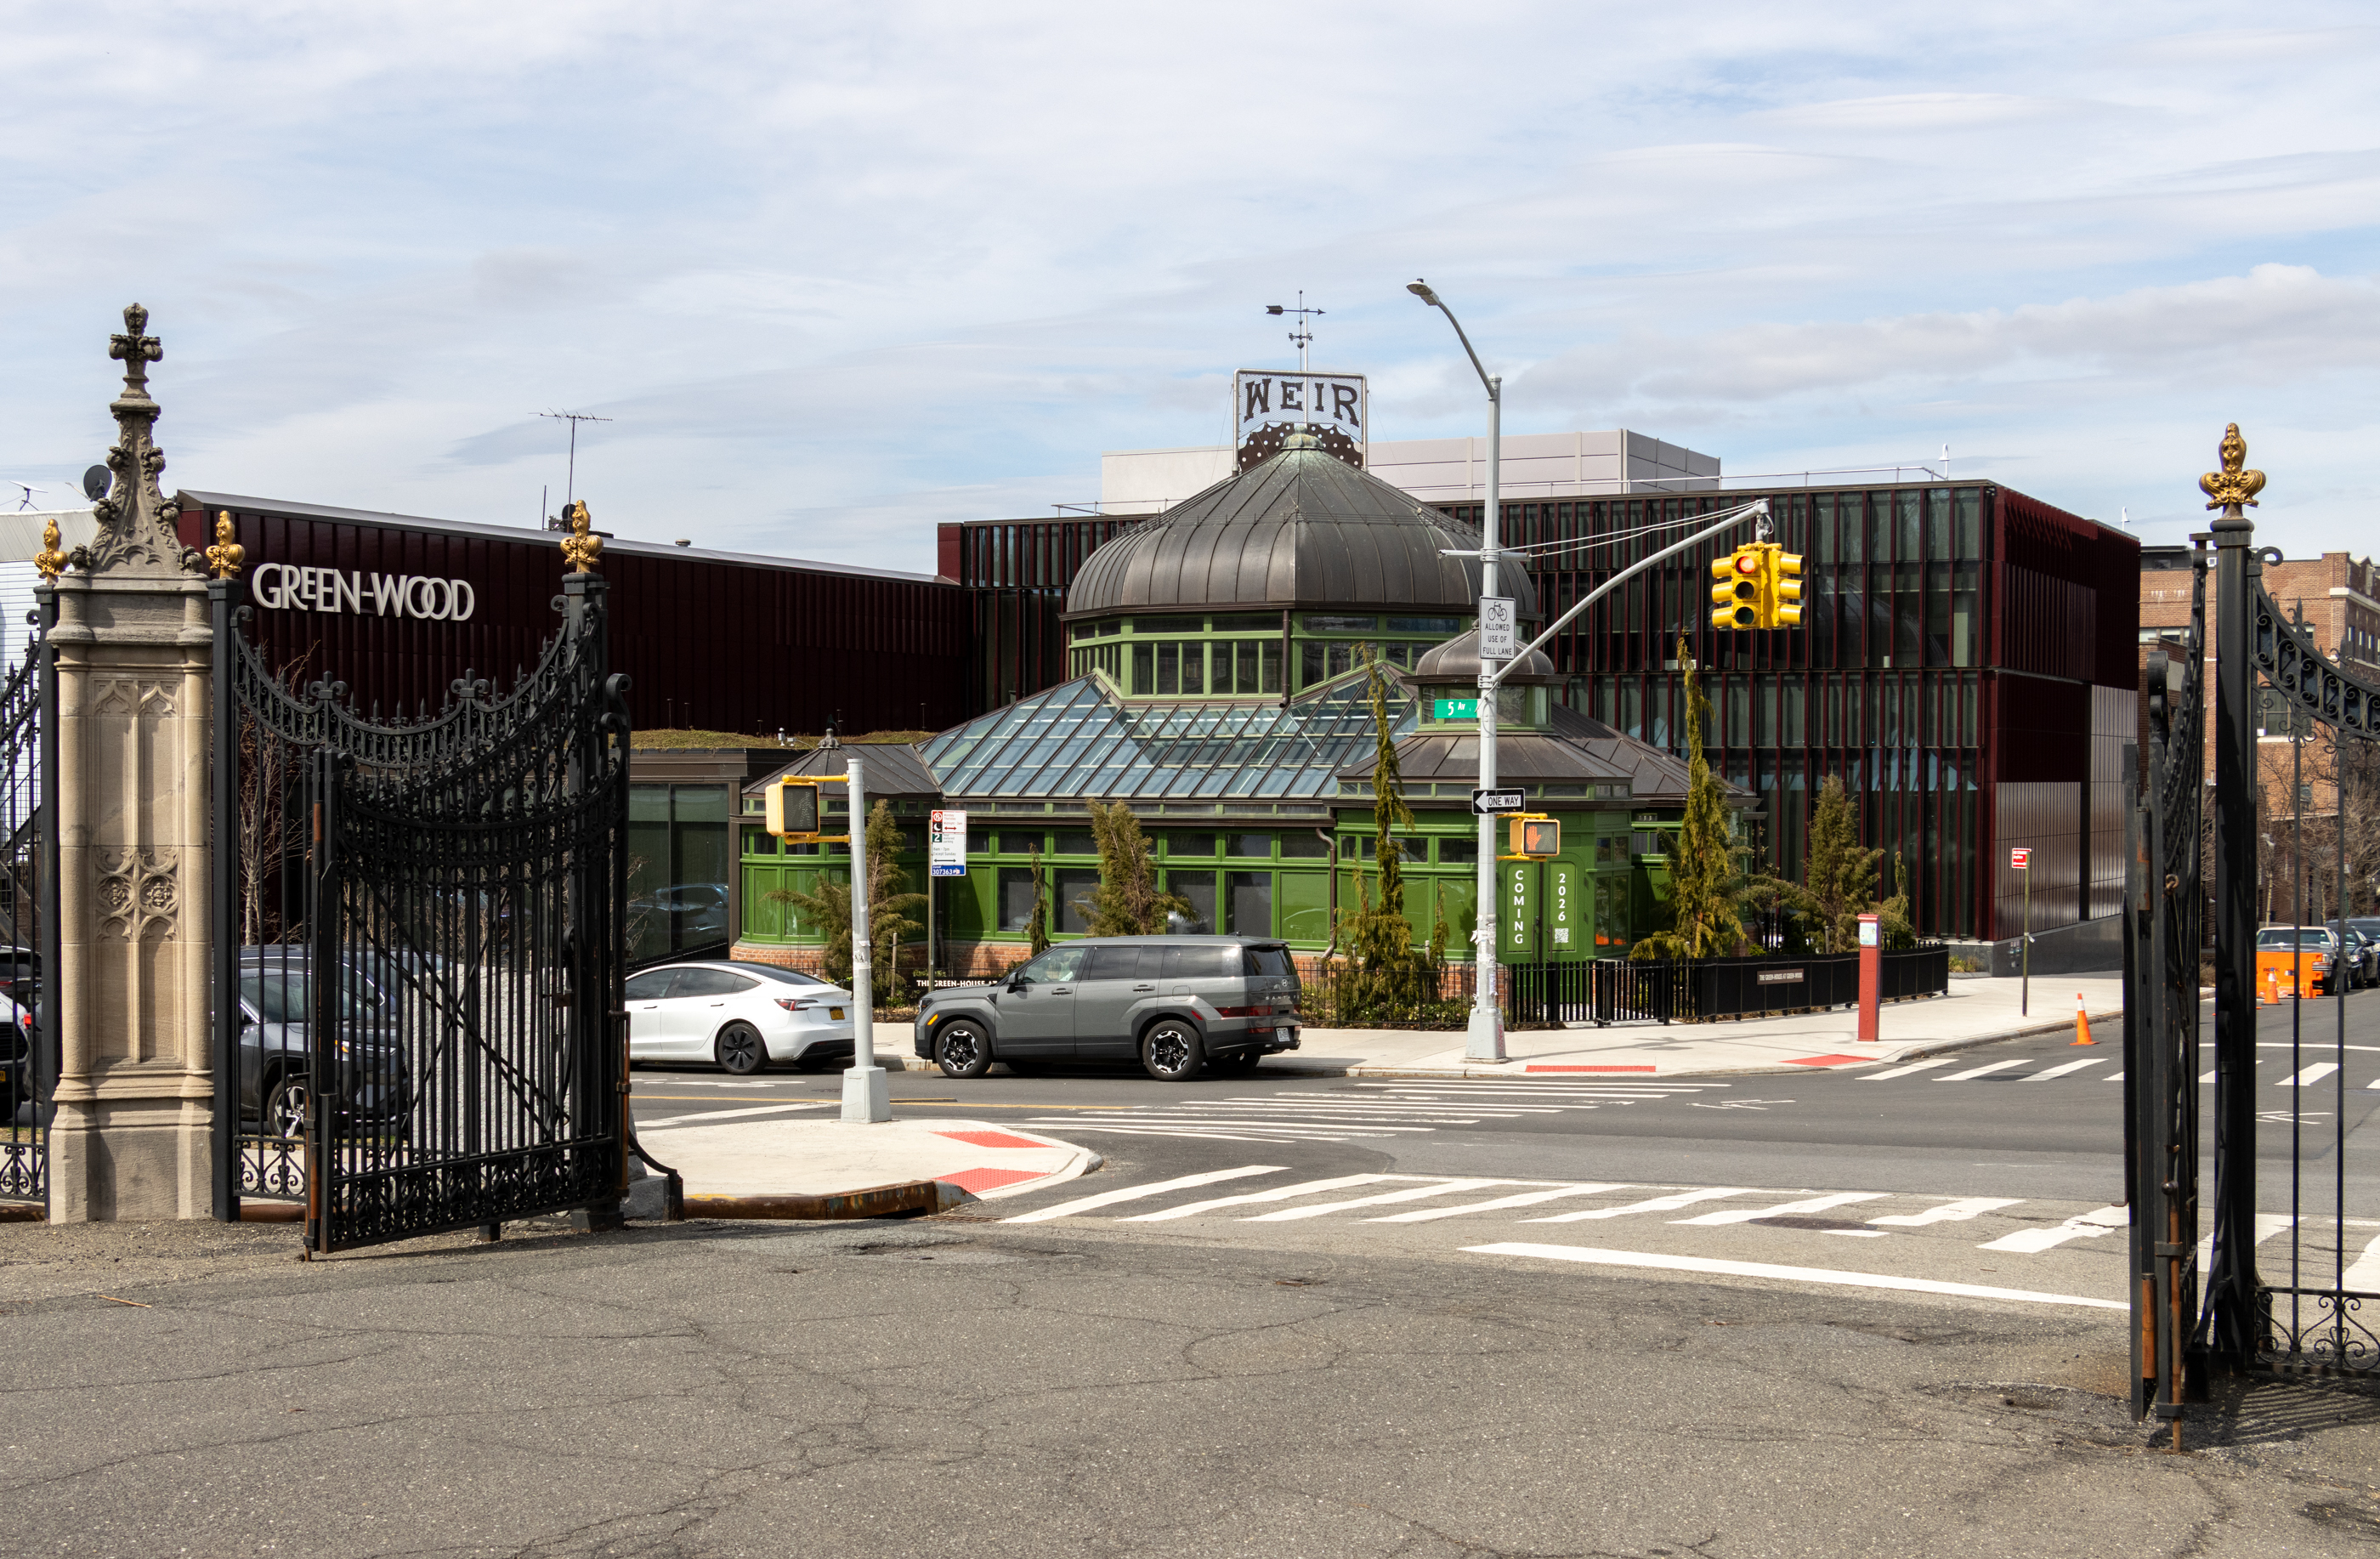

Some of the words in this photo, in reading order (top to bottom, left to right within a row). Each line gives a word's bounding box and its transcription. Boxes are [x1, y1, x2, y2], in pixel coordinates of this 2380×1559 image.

[1244, 377, 1360, 428] WEIR
[252, 562, 475, 621] GREEN-WOOD
[1485, 623, 1510, 632] ALLOWED
[1488, 635, 1499, 643] USE
[1482, 647, 1496, 655] FULL
[1448, 701, 1454, 716] 5
[1457, 701, 1466, 711] Av
[1488, 797, 1503, 807] ONE
[1504, 796, 1519, 806] WAY
[934, 834, 940, 842] 2
[1558, 873, 1567, 921] 2026
[1514, 870, 1525, 944] COMING
